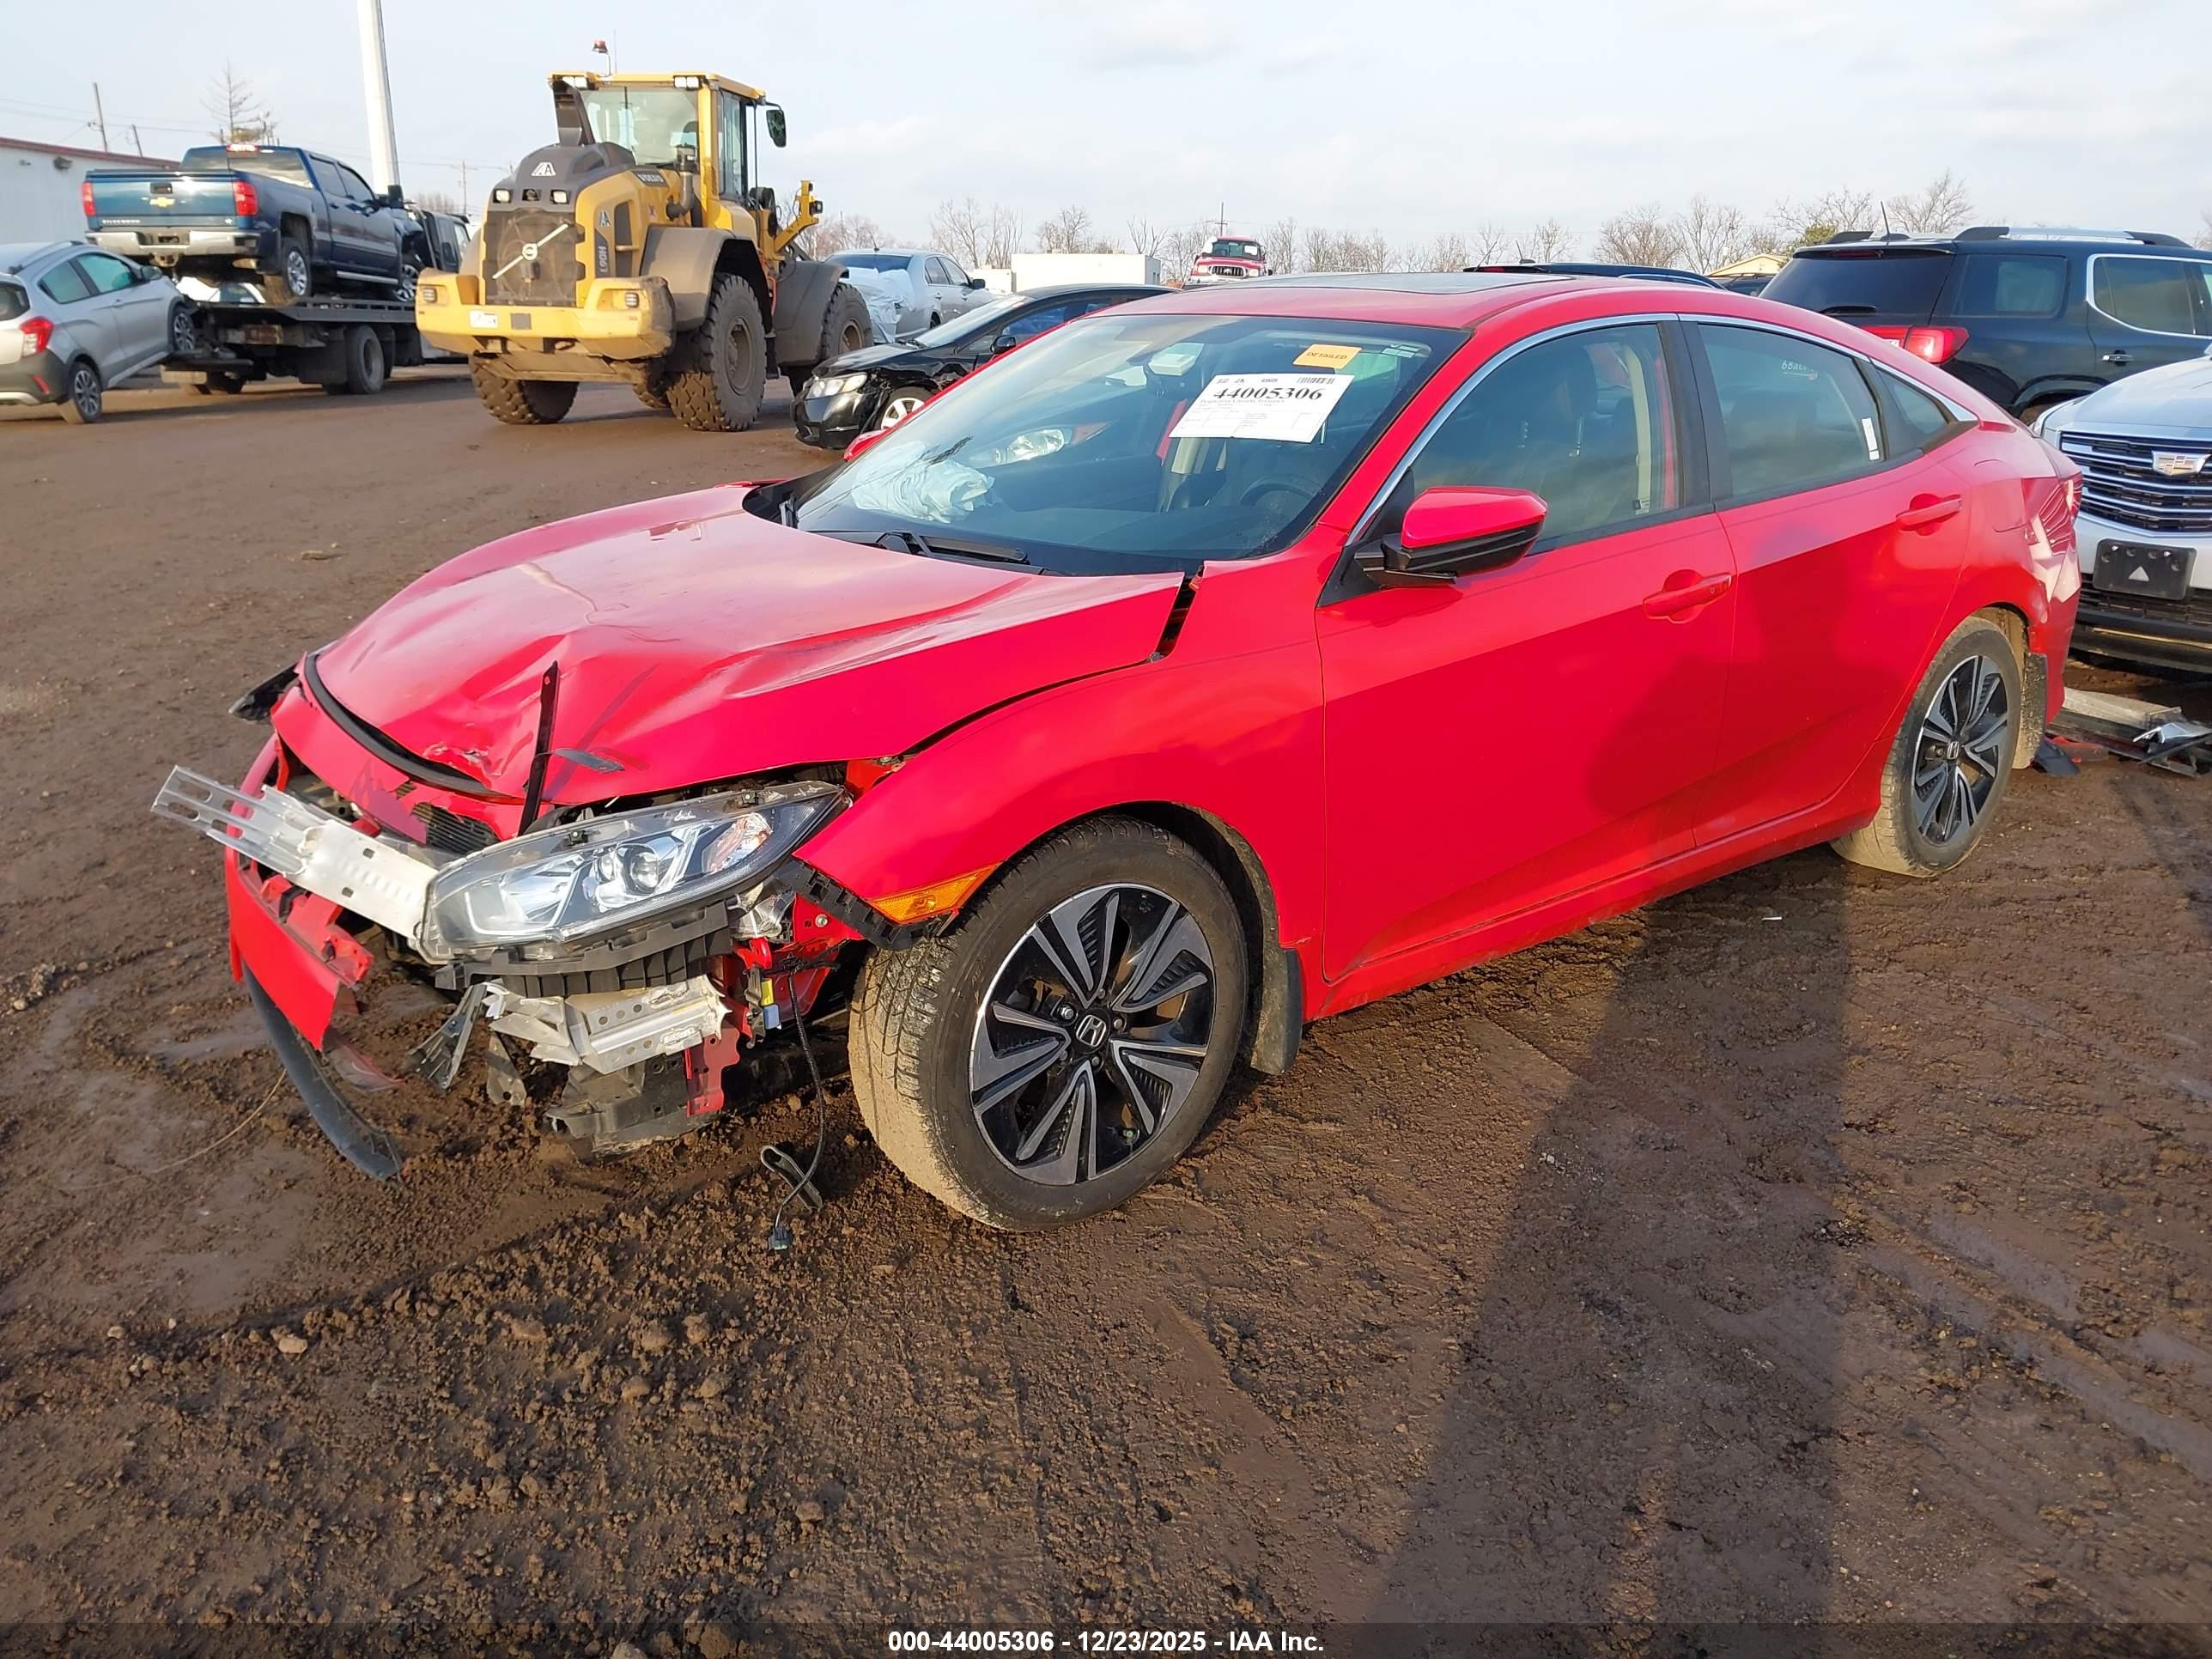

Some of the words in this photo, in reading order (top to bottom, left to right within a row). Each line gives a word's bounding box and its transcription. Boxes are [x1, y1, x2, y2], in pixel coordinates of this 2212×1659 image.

[636, 173, 664, 183] VOLVO
[598, 246, 609, 273] L90H
[1306, 351, 1347, 360] DETAILED
[1213, 386, 1326, 400] 44005306
